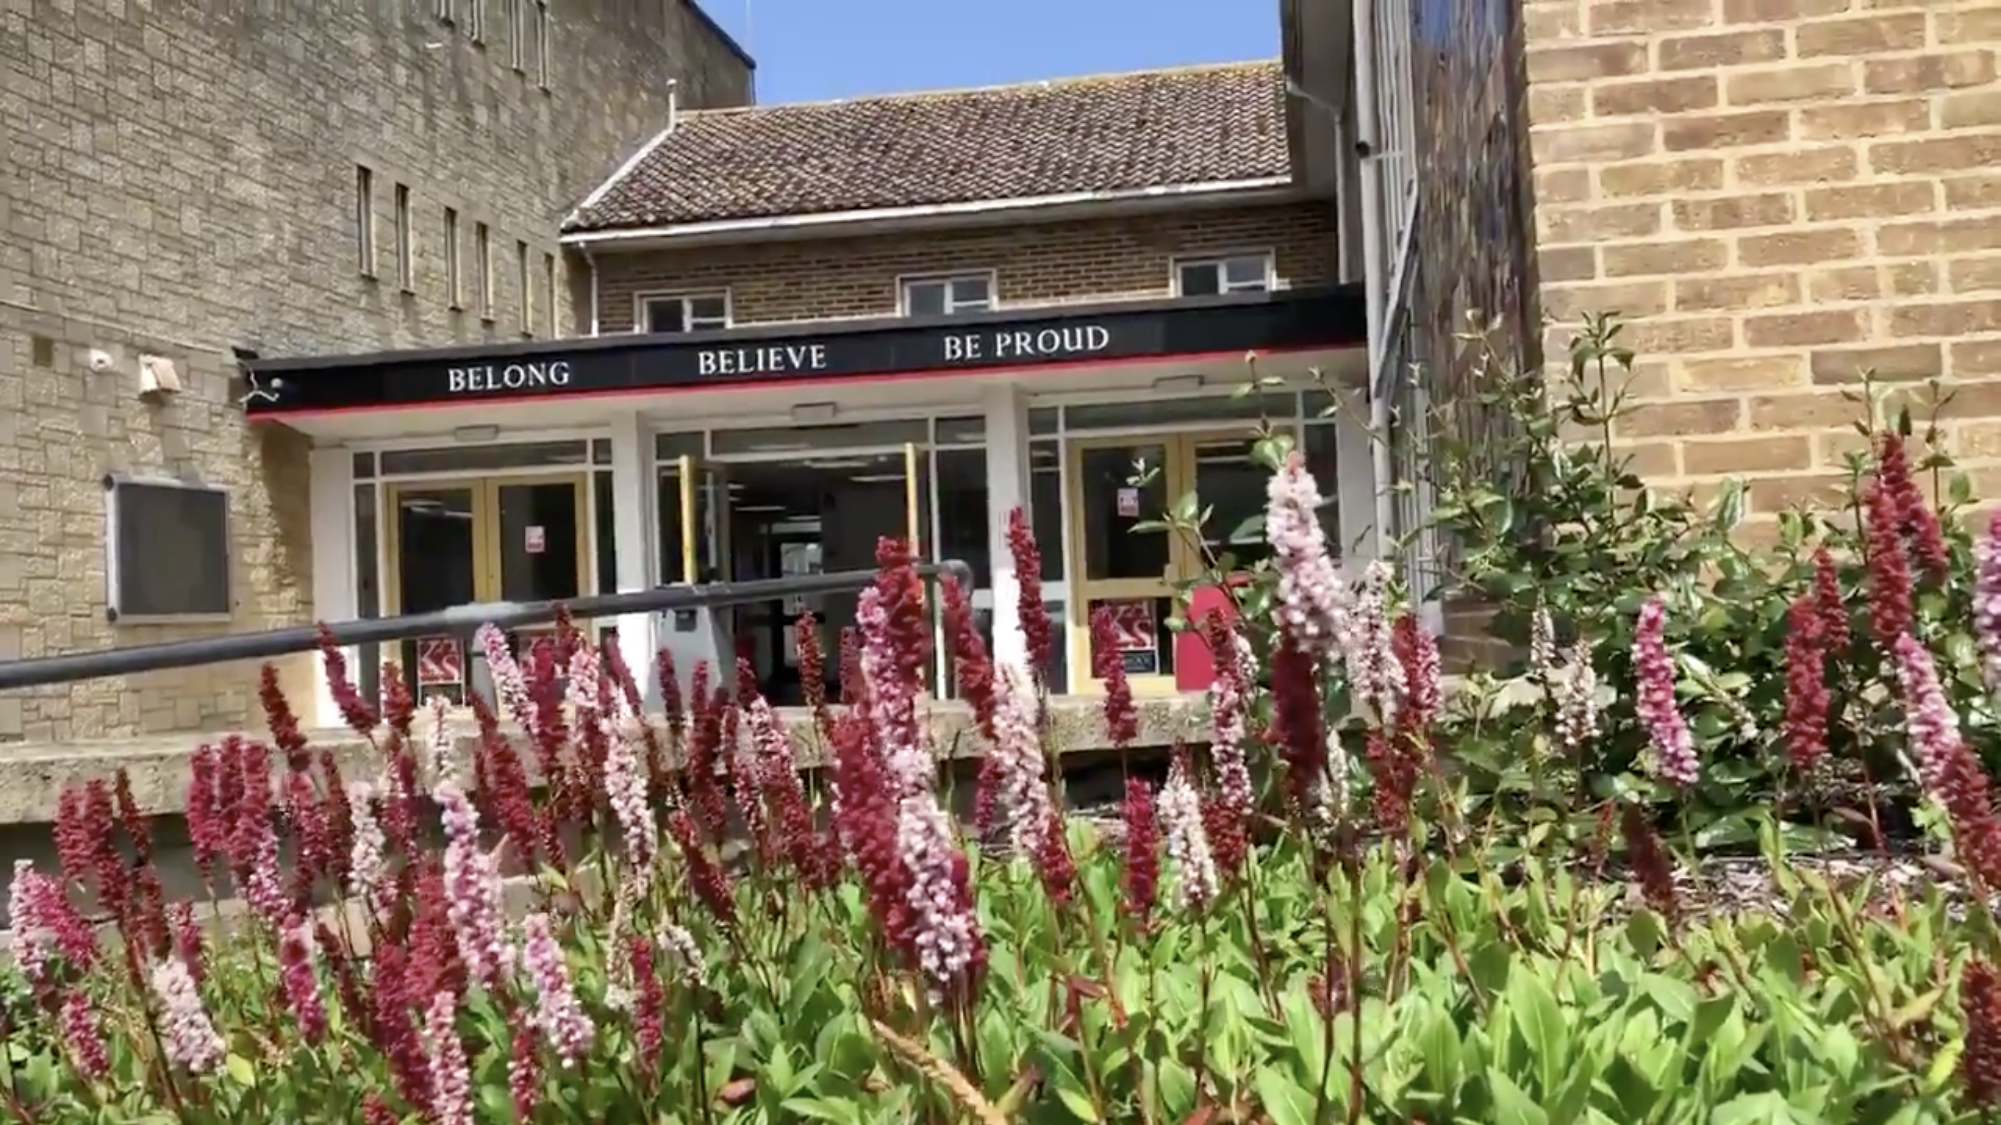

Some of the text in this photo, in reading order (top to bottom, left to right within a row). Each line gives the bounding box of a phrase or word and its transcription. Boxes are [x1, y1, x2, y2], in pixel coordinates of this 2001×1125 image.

[447, 325, 1111, 393] BELONG BELIEVE BE PROUD
